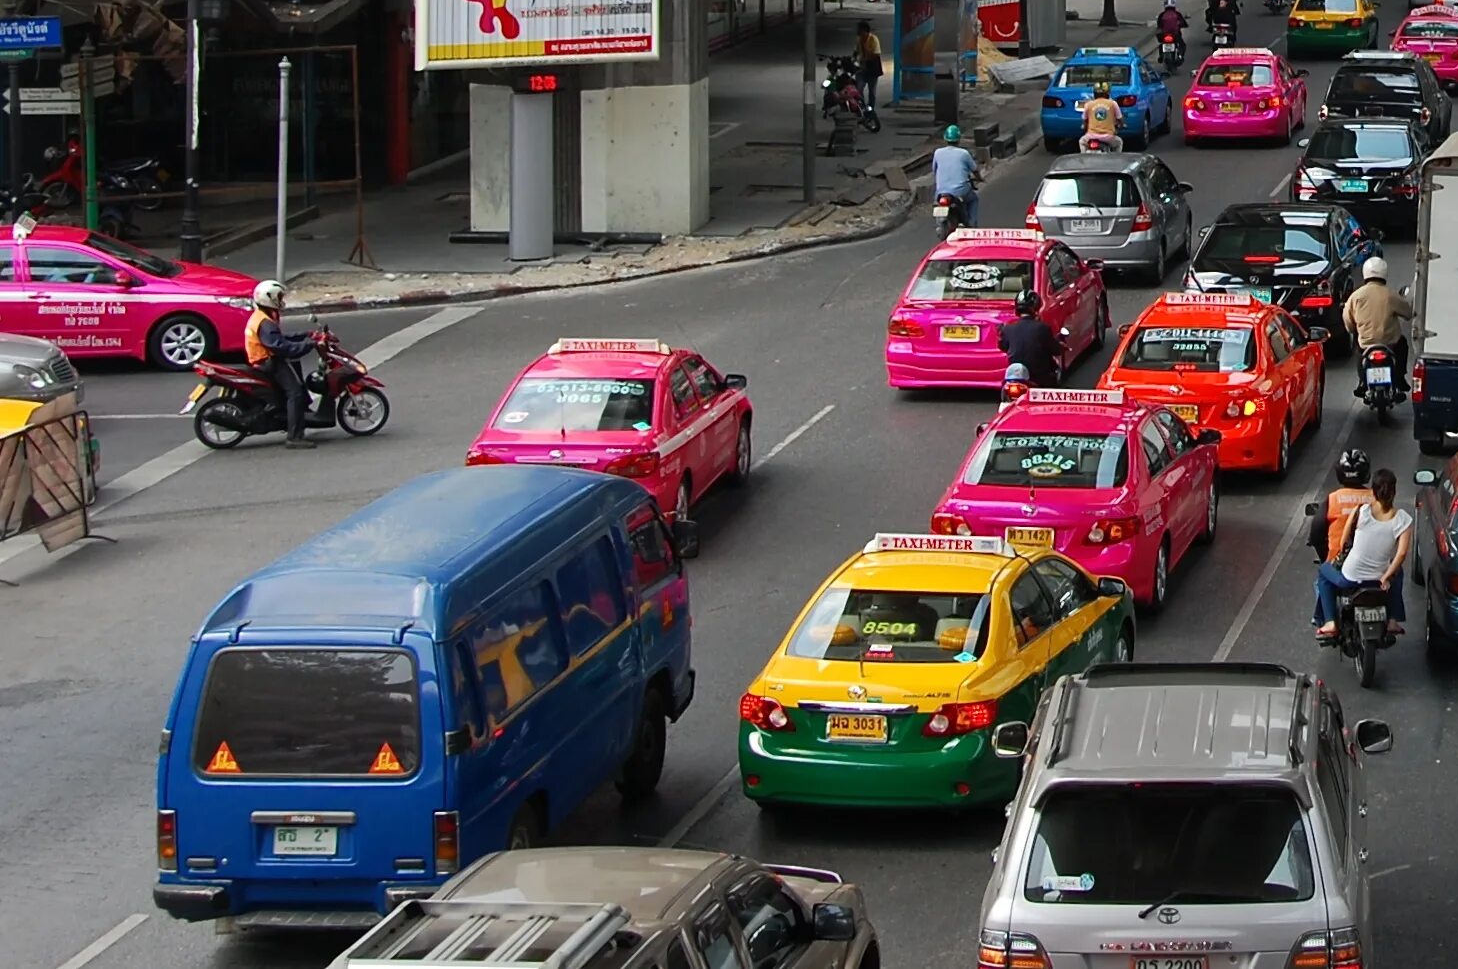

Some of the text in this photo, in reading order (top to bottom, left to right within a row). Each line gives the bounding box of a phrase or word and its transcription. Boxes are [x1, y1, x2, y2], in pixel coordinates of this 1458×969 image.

[1179, 294, 1236, 303] TAXI-METER
[572, 341, 638, 351] TAXI-METER
[1041, 391, 1109, 403] TAXI-METER
[1021, 453, 1076, 470] 88315
[1027, 528, 1051, 541] 1427
[892, 537, 973, 551] TAXI-METER
[862, 621, 917, 635] 8504
[853, 716, 884, 731] 3031
[211, 750, 237, 771] Sika
[374, 751, 400, 771] Sika
